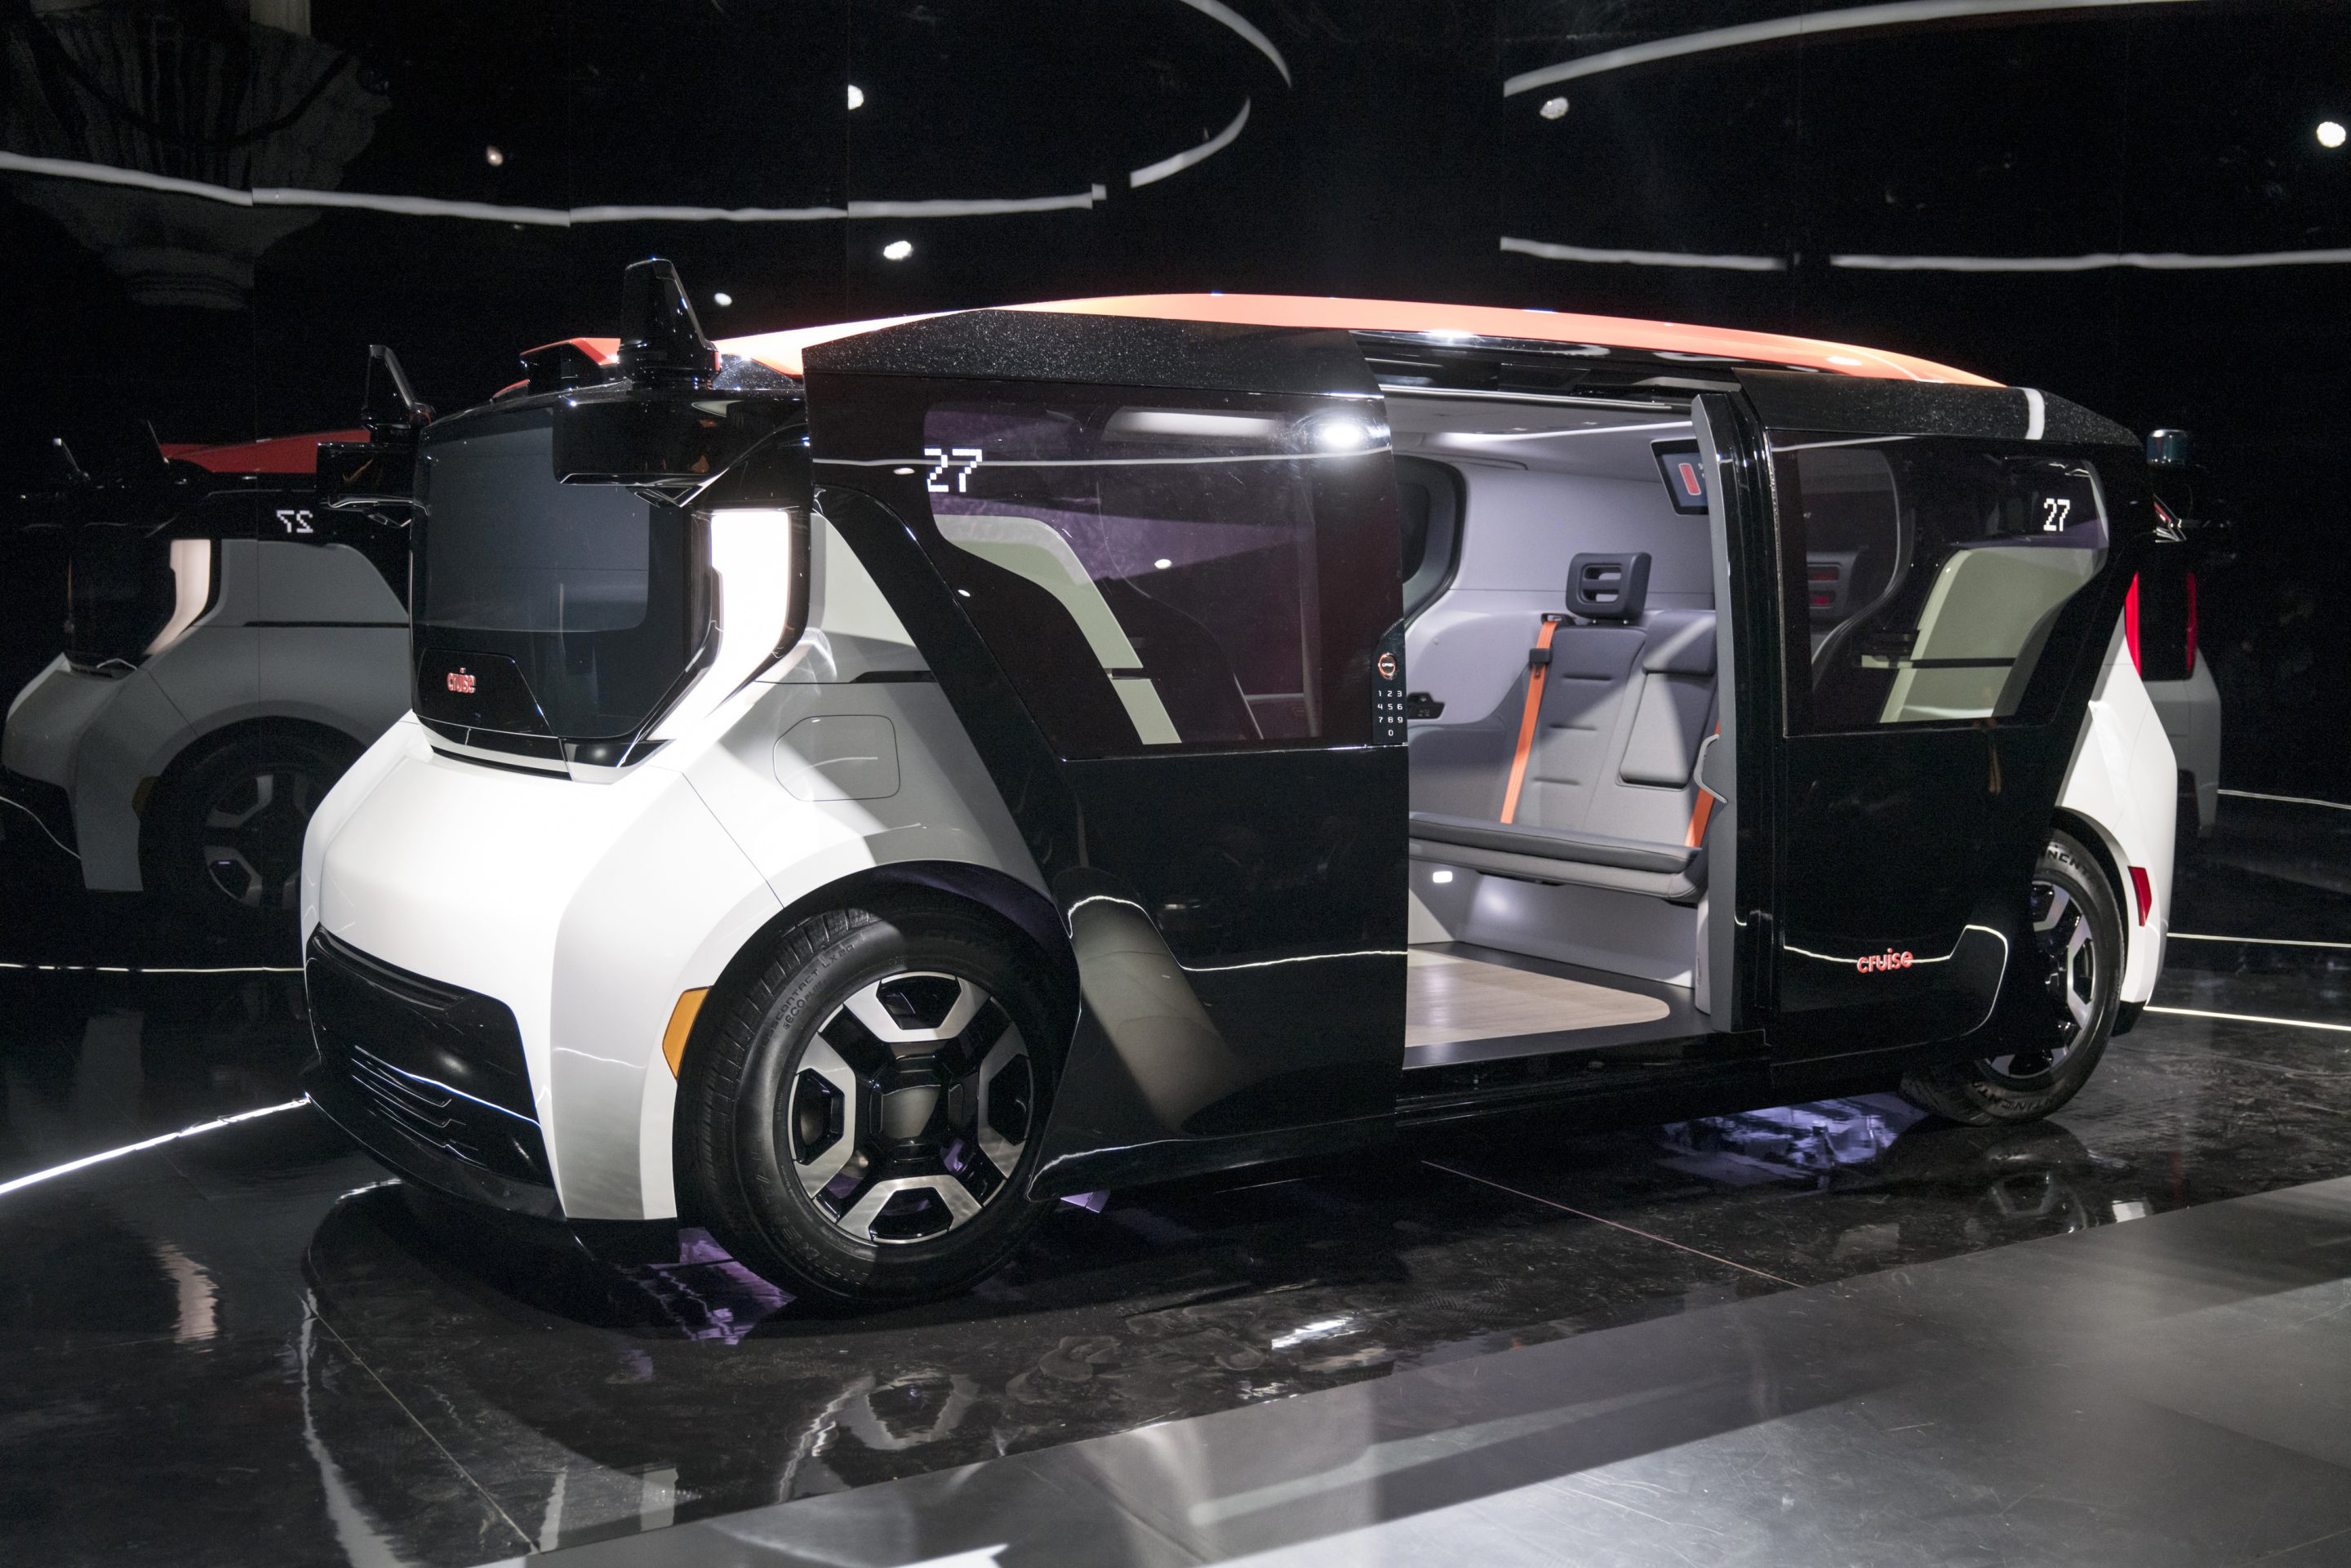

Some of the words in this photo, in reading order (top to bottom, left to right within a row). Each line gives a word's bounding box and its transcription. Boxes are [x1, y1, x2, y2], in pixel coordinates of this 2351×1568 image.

[924, 448, 982, 492] 27
[2043, 498, 2070, 531] 27
[447, 667, 477, 694] cruise
[1856, 948, 1913, 973] cruise
